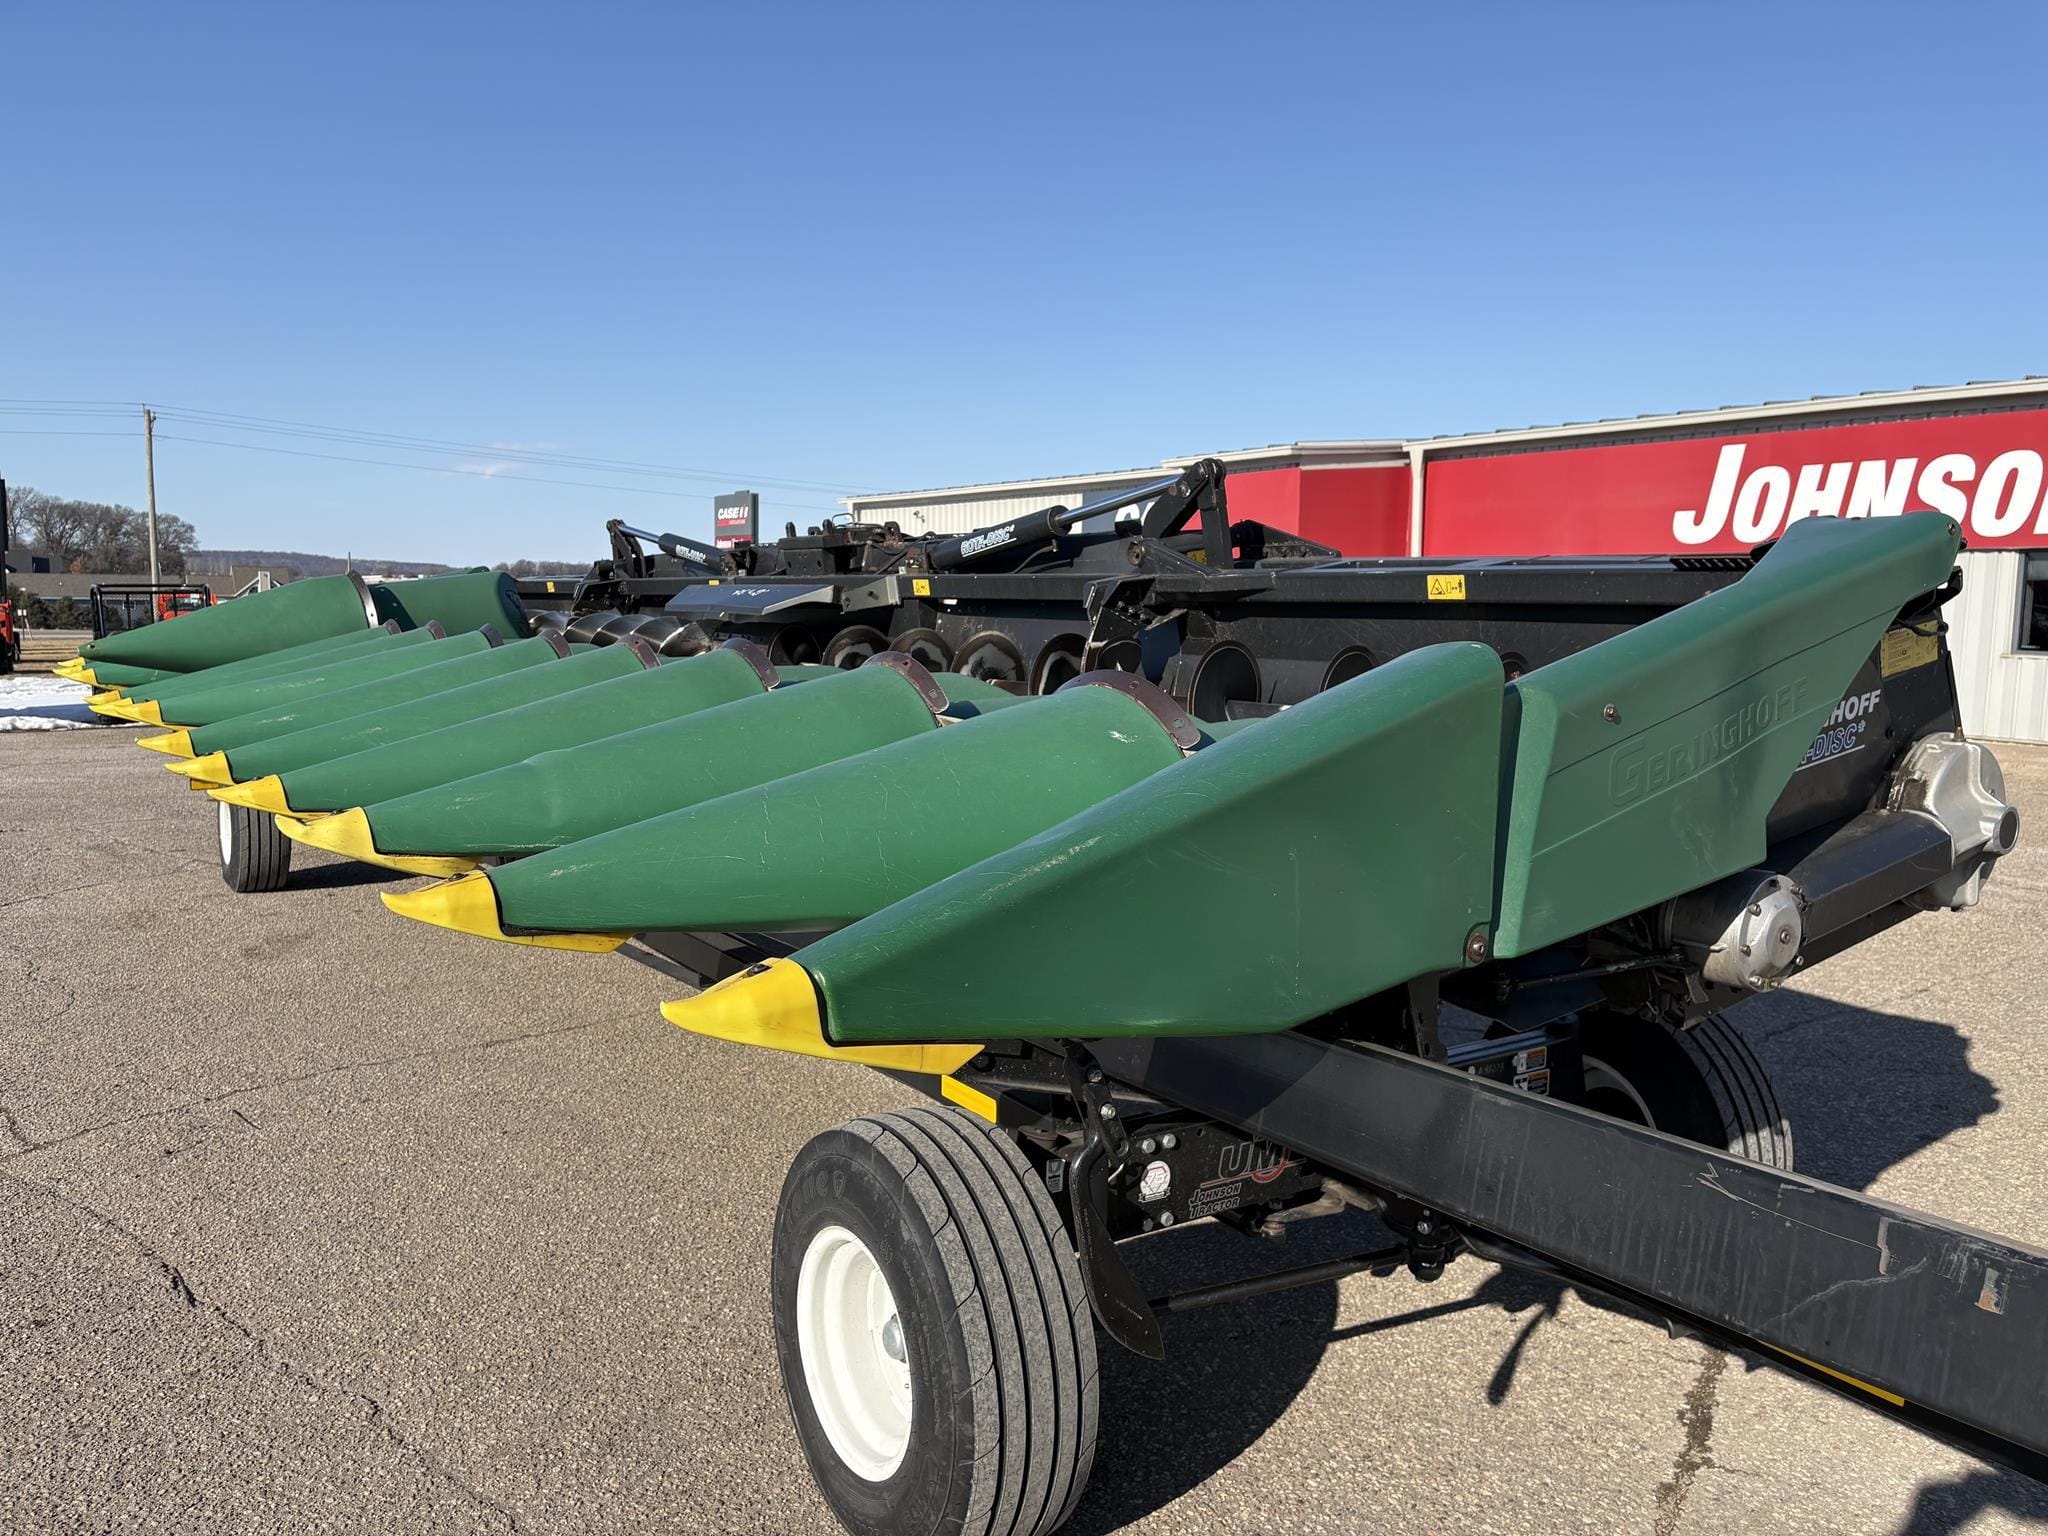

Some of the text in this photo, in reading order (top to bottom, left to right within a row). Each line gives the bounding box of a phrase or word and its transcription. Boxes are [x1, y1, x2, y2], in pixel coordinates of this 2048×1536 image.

[1672, 442, 2048, 545] JOHNSO
[718, 506, 740, 520] CASE
[961, 526, 1010, 555] ROTA-DISC
[1824, 689, 1881, 727] HOFF
[1188, 1182, 1242, 1206] JOHNSON
[1188, 1197, 1241, 1219] TRACTOR
